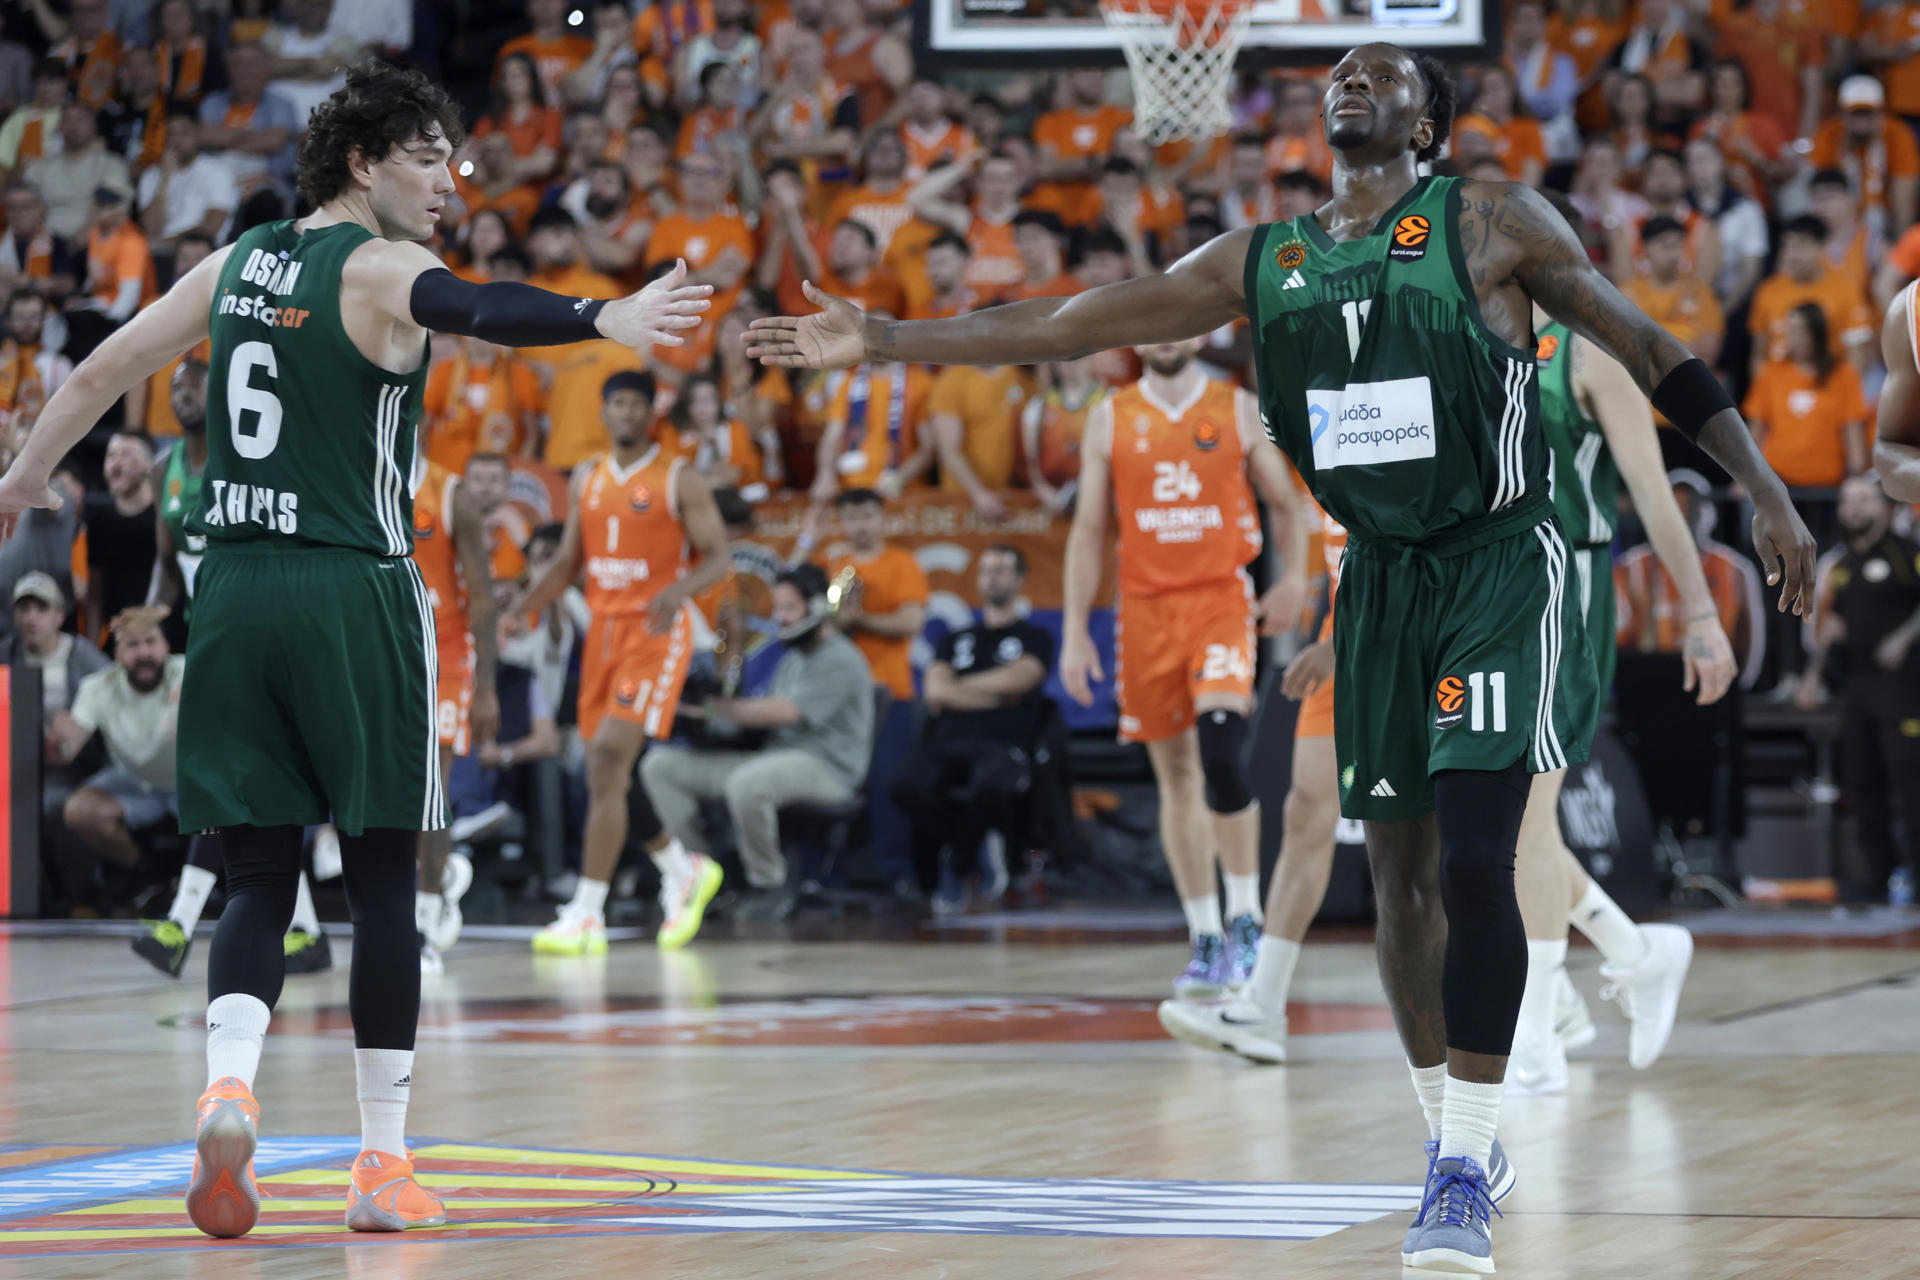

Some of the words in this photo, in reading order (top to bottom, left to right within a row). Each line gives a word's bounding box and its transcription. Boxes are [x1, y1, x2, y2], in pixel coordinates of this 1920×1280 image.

[227, 341, 283, 460] 6
[1153, 460, 1203, 502] 24
[607, 515, 620, 553] 1
[1135, 505, 1224, 532] VALENCIA
[1203, 643, 1248, 682] 24
[1468, 671, 1507, 732] 11
